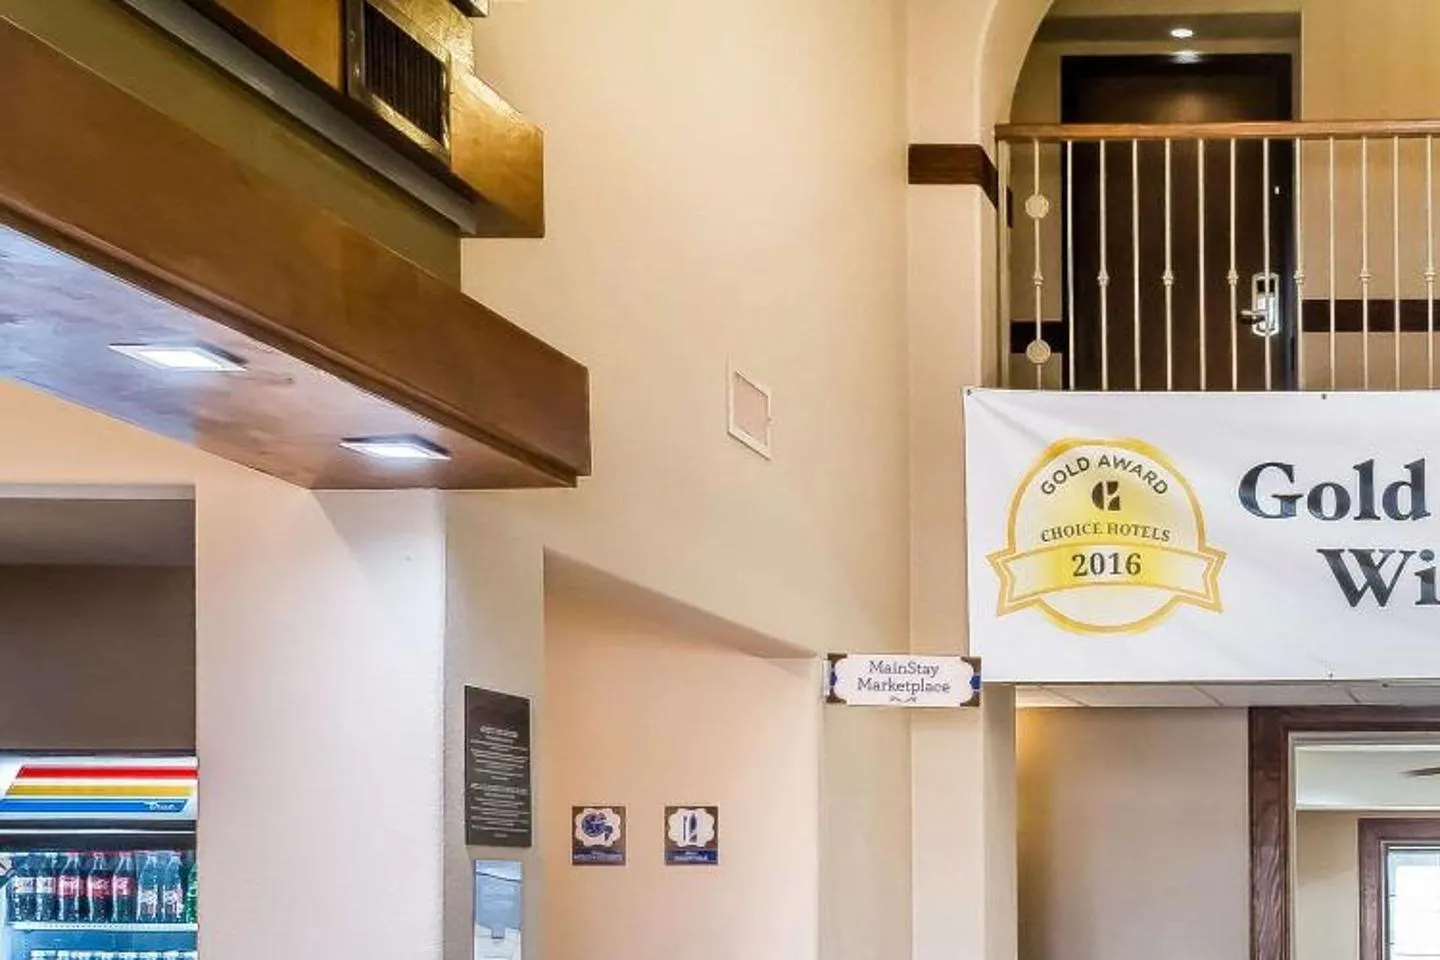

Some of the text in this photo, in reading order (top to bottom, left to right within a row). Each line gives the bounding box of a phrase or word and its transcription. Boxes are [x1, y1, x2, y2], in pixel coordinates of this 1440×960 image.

[1041, 454, 1168, 495] GOLD AWARD
[1238, 458, 1431, 521] Gold
[1041, 521, 1170, 542] CHOICE HOTELS
[1072, 552, 1142, 577] 2016
[869, 660, 939, 678] MainStay
[857, 678, 951, 695] Marketplace
